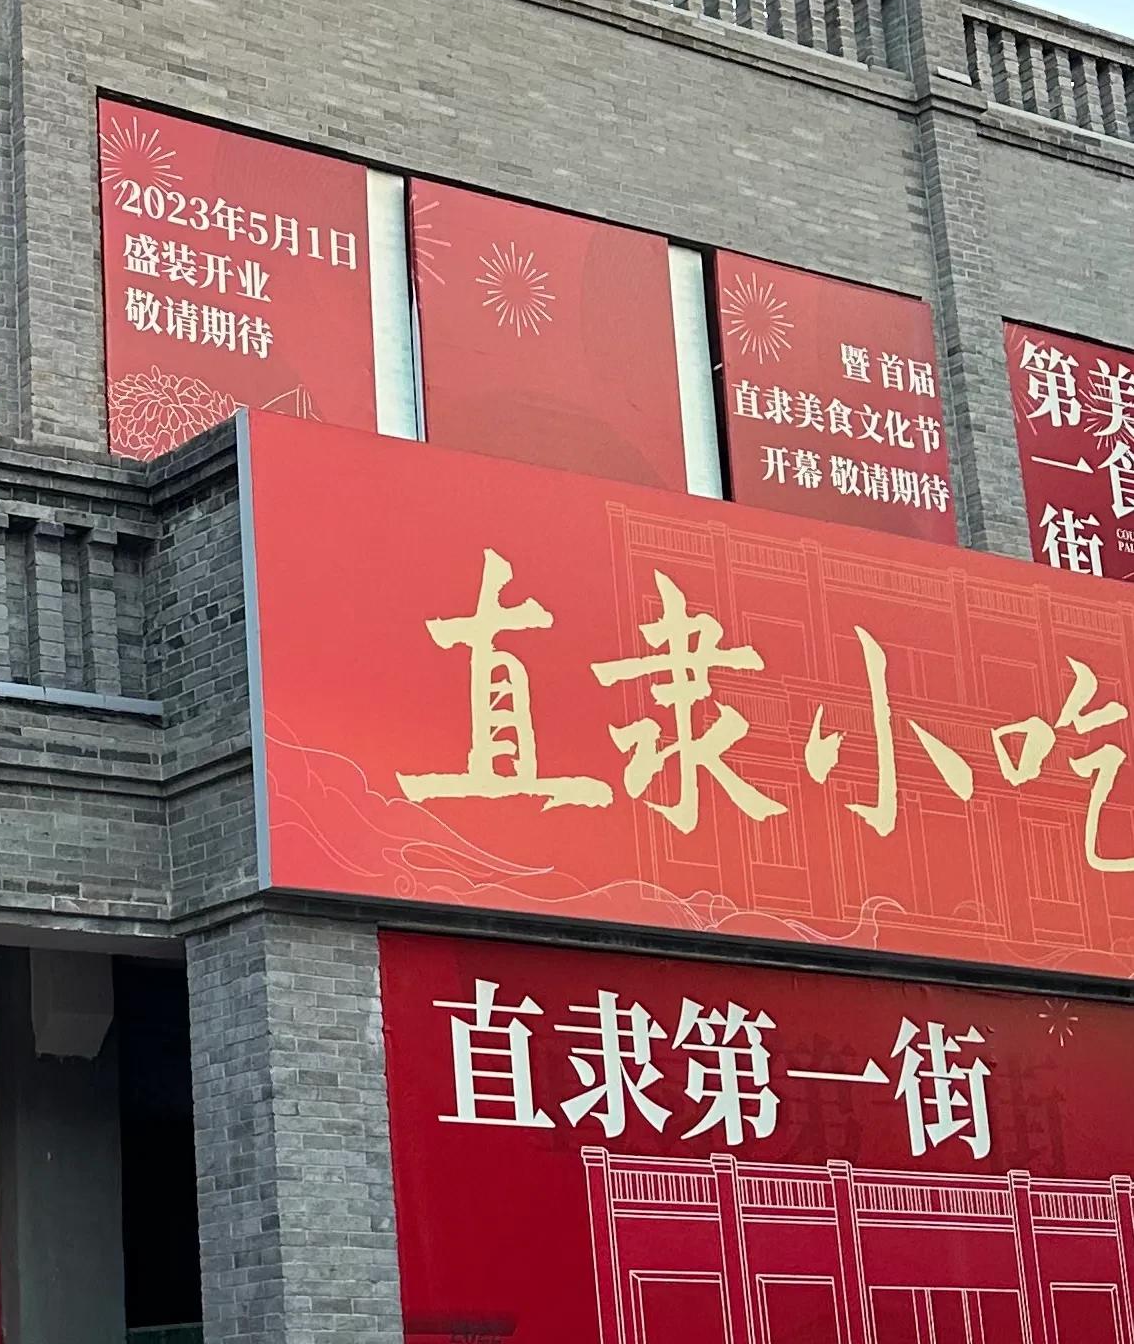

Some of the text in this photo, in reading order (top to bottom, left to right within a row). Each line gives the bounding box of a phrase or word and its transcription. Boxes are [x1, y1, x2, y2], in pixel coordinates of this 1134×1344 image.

[121, 179, 358, 270] 2023年5月1日
[123, 233, 272, 304] 盛装开业
[123, 286, 274, 360] 敬请期待
[840, 343, 937, 398] 暨 首届
[731, 379, 942, 454] 直隶美食文化节
[760, 445, 951, 514] 开幕 敬请期待
[396, 548, 1134, 873] 直隶小吃
[433, 978, 992, 1160] 直隶第一街
